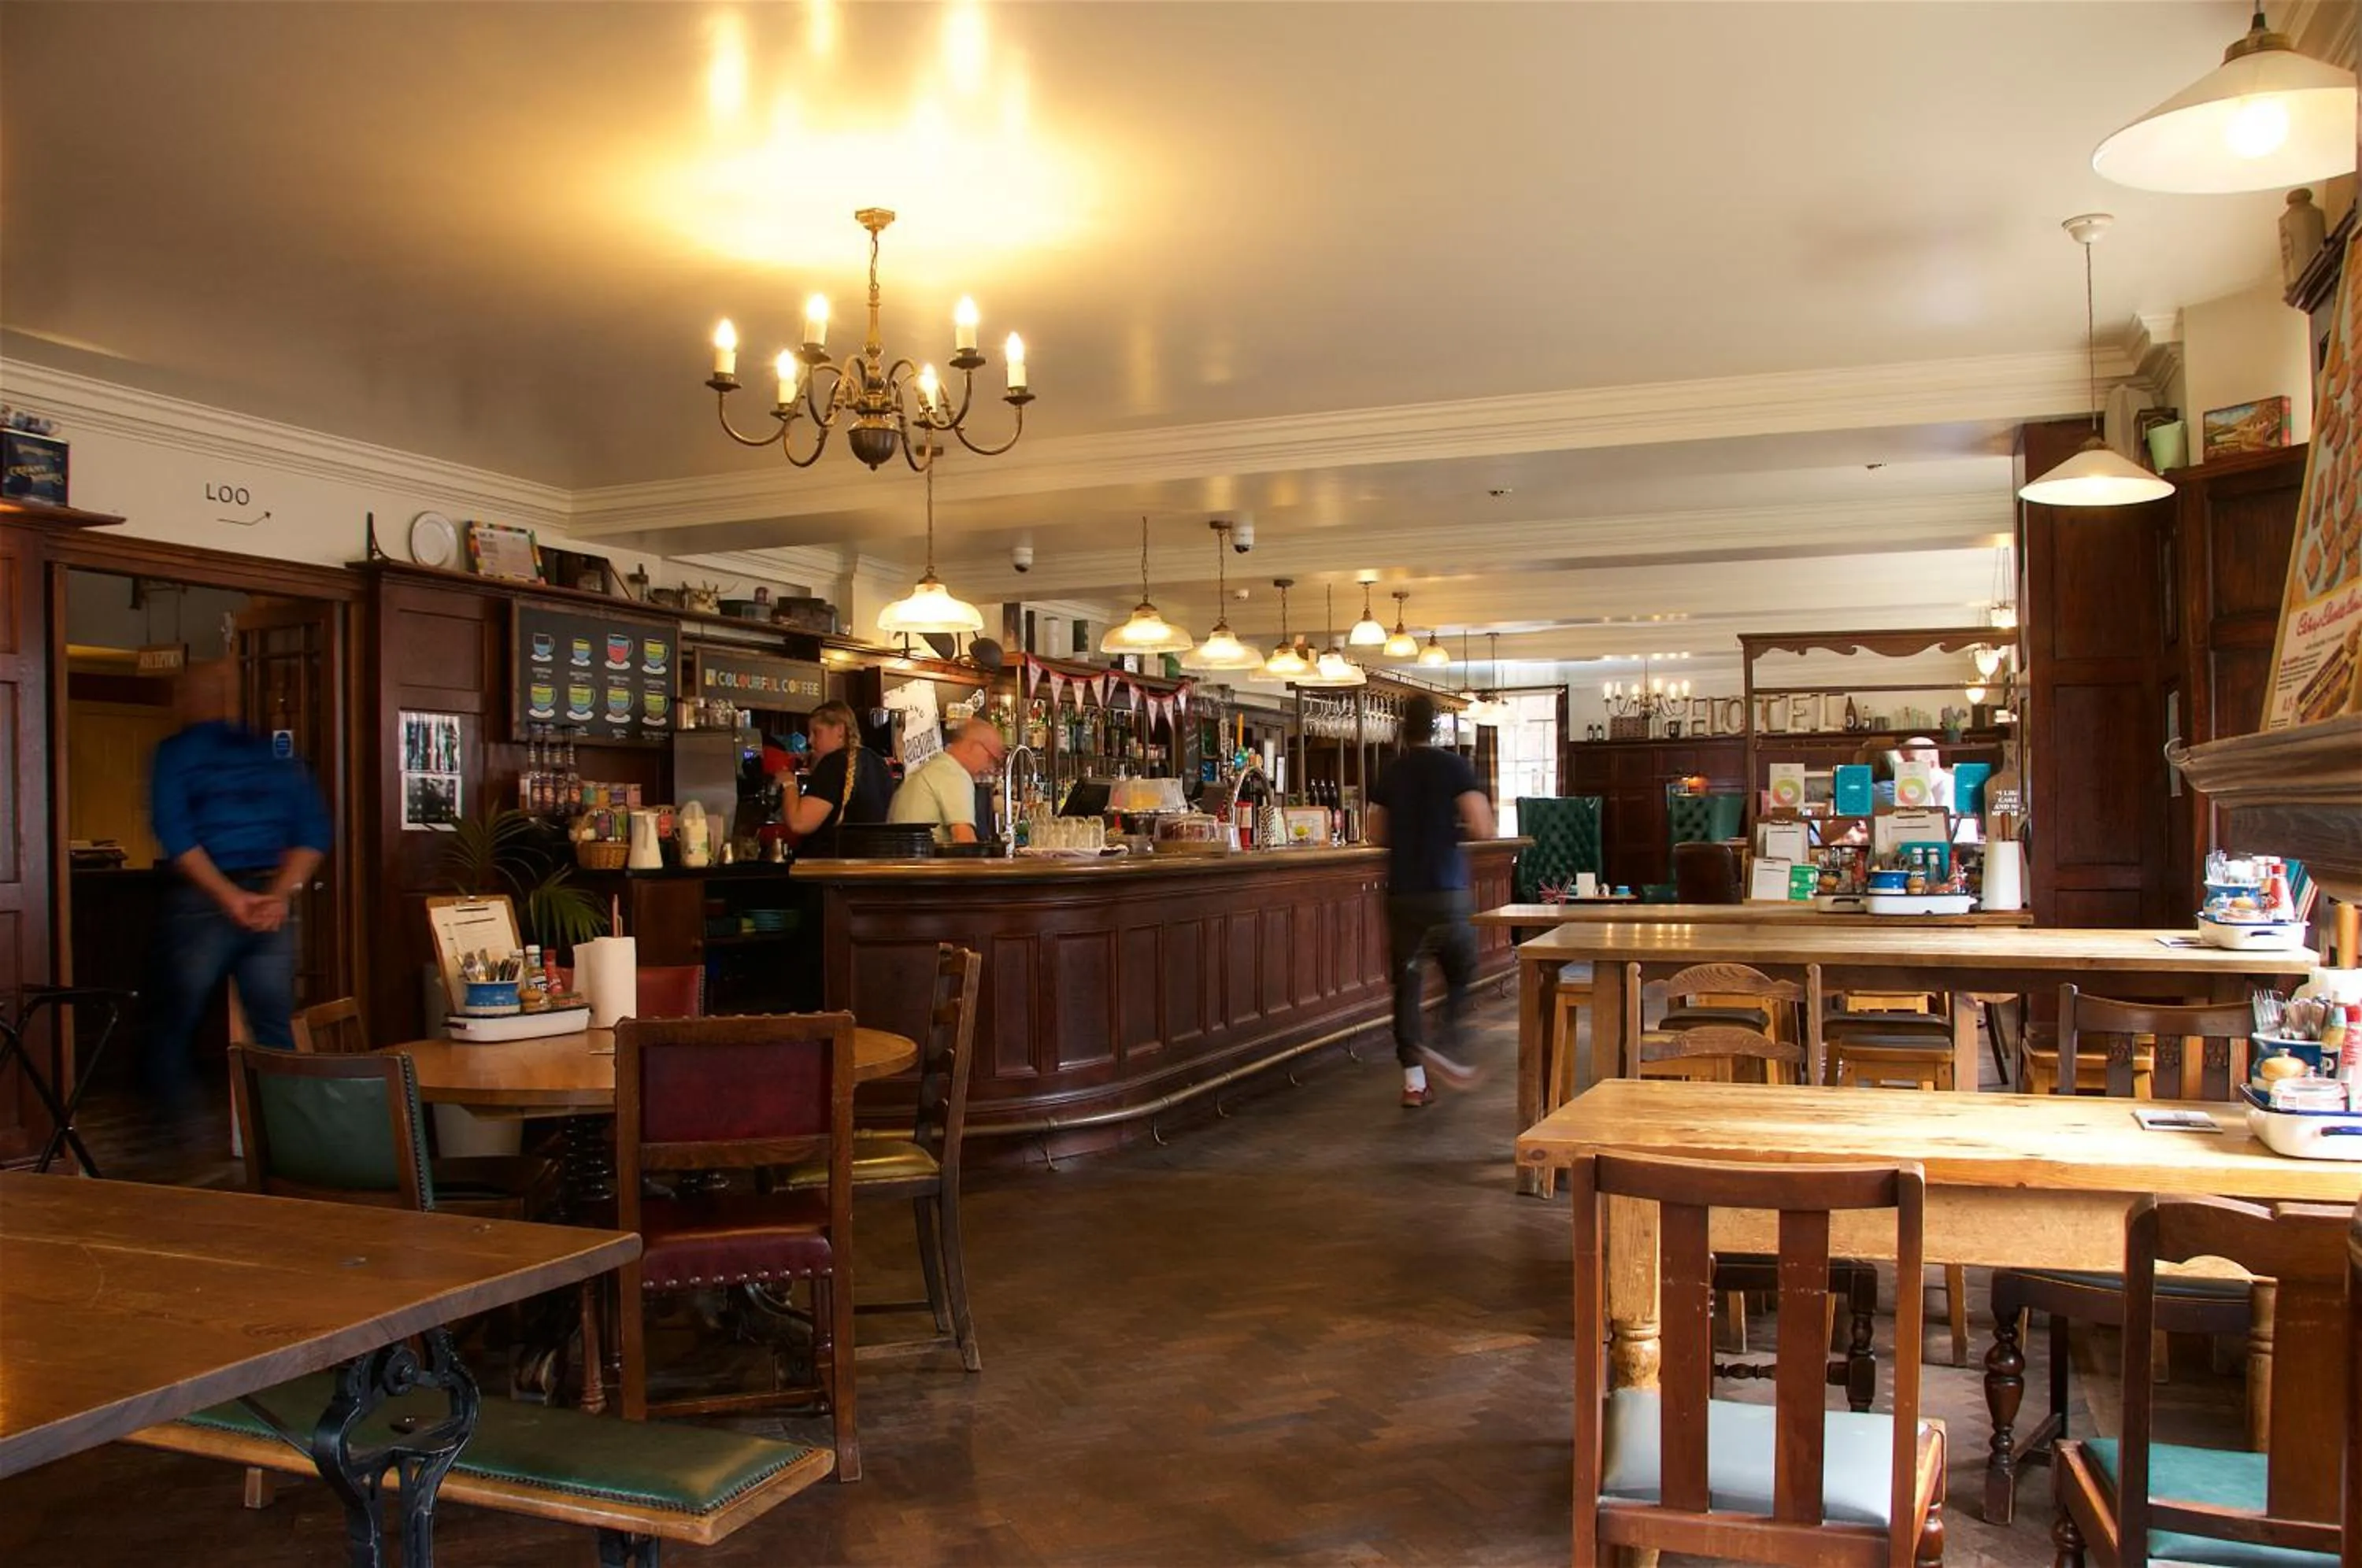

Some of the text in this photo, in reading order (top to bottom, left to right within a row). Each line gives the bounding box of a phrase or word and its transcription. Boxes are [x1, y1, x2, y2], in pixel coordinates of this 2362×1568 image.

[205, 483, 250, 506] LOO
[717, 671, 820, 697] COLOURFUL COFFEE
[1683, 691, 1844, 738] HOTEL
